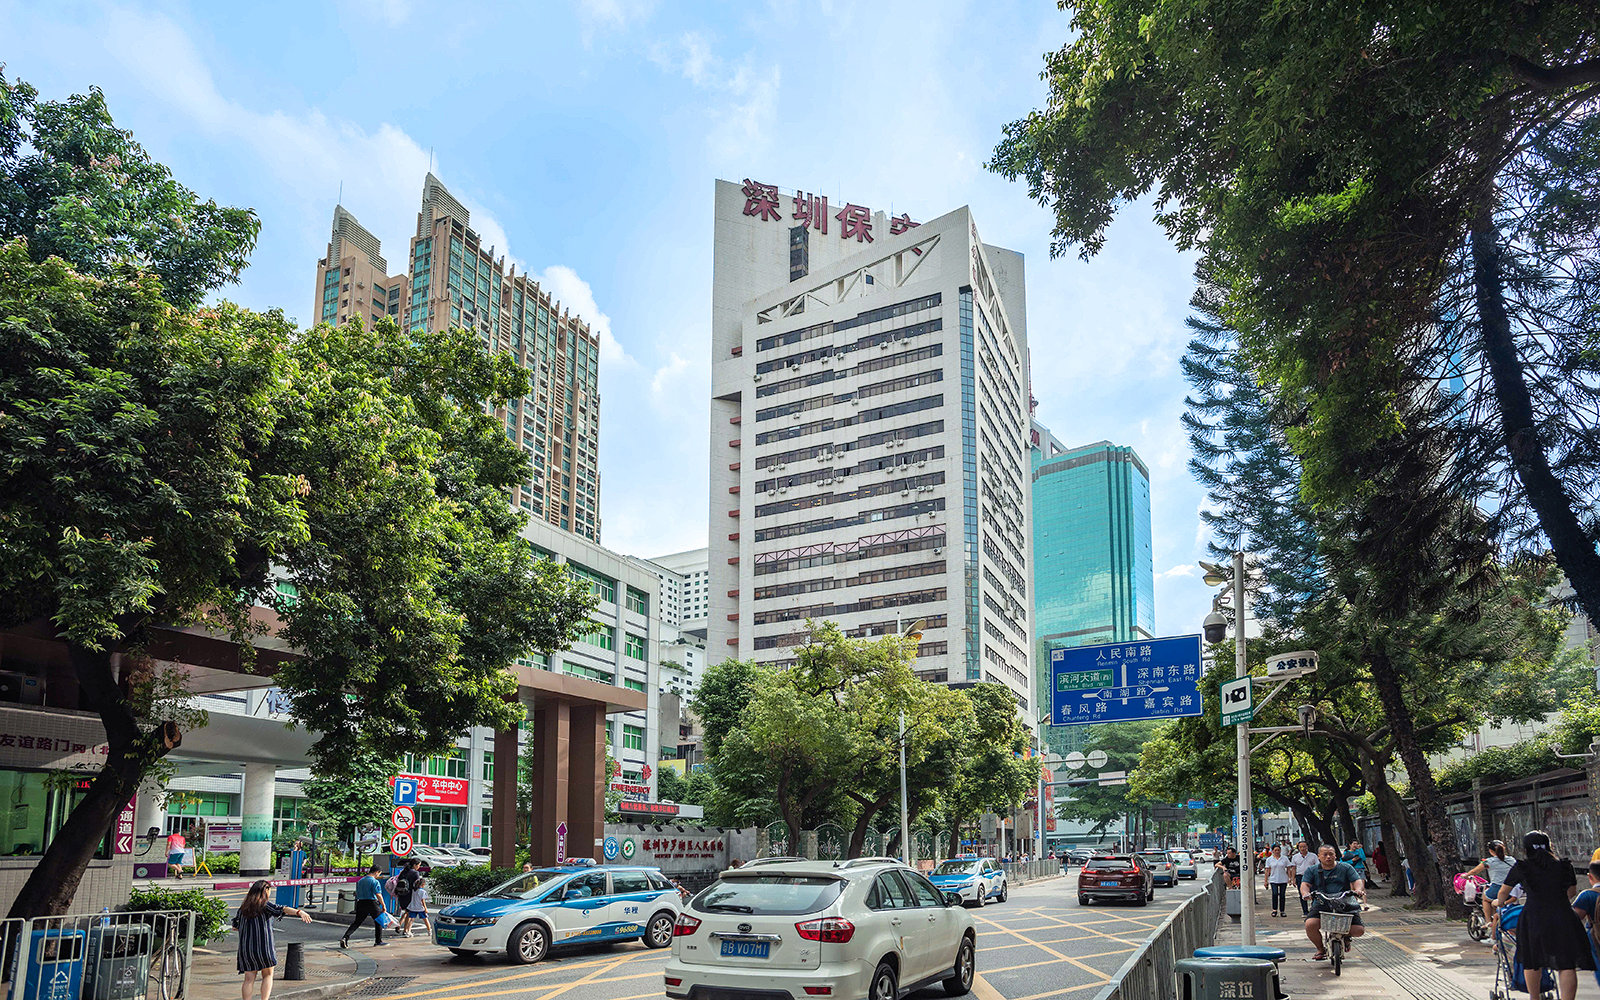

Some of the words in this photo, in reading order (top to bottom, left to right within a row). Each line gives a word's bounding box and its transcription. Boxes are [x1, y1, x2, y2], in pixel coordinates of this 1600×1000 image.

[1096, 645, 1152, 661] 人民南路
[1137, 664, 1196, 679] 深南东路
[1103, 687, 1147, 698] 南湖路
[1061, 702, 1108, 715] 春风路
[1144, 695, 1192, 709] 嘉宾路
[432, 779, 462, 791] 卒中中心
[611, 783, 650, 794] EMERGENCY
[399, 782, 412, 802] P
[395, 837, 408, 851] 15
[643, 839, 724, 852] 深圳市罗湖区人民医院
